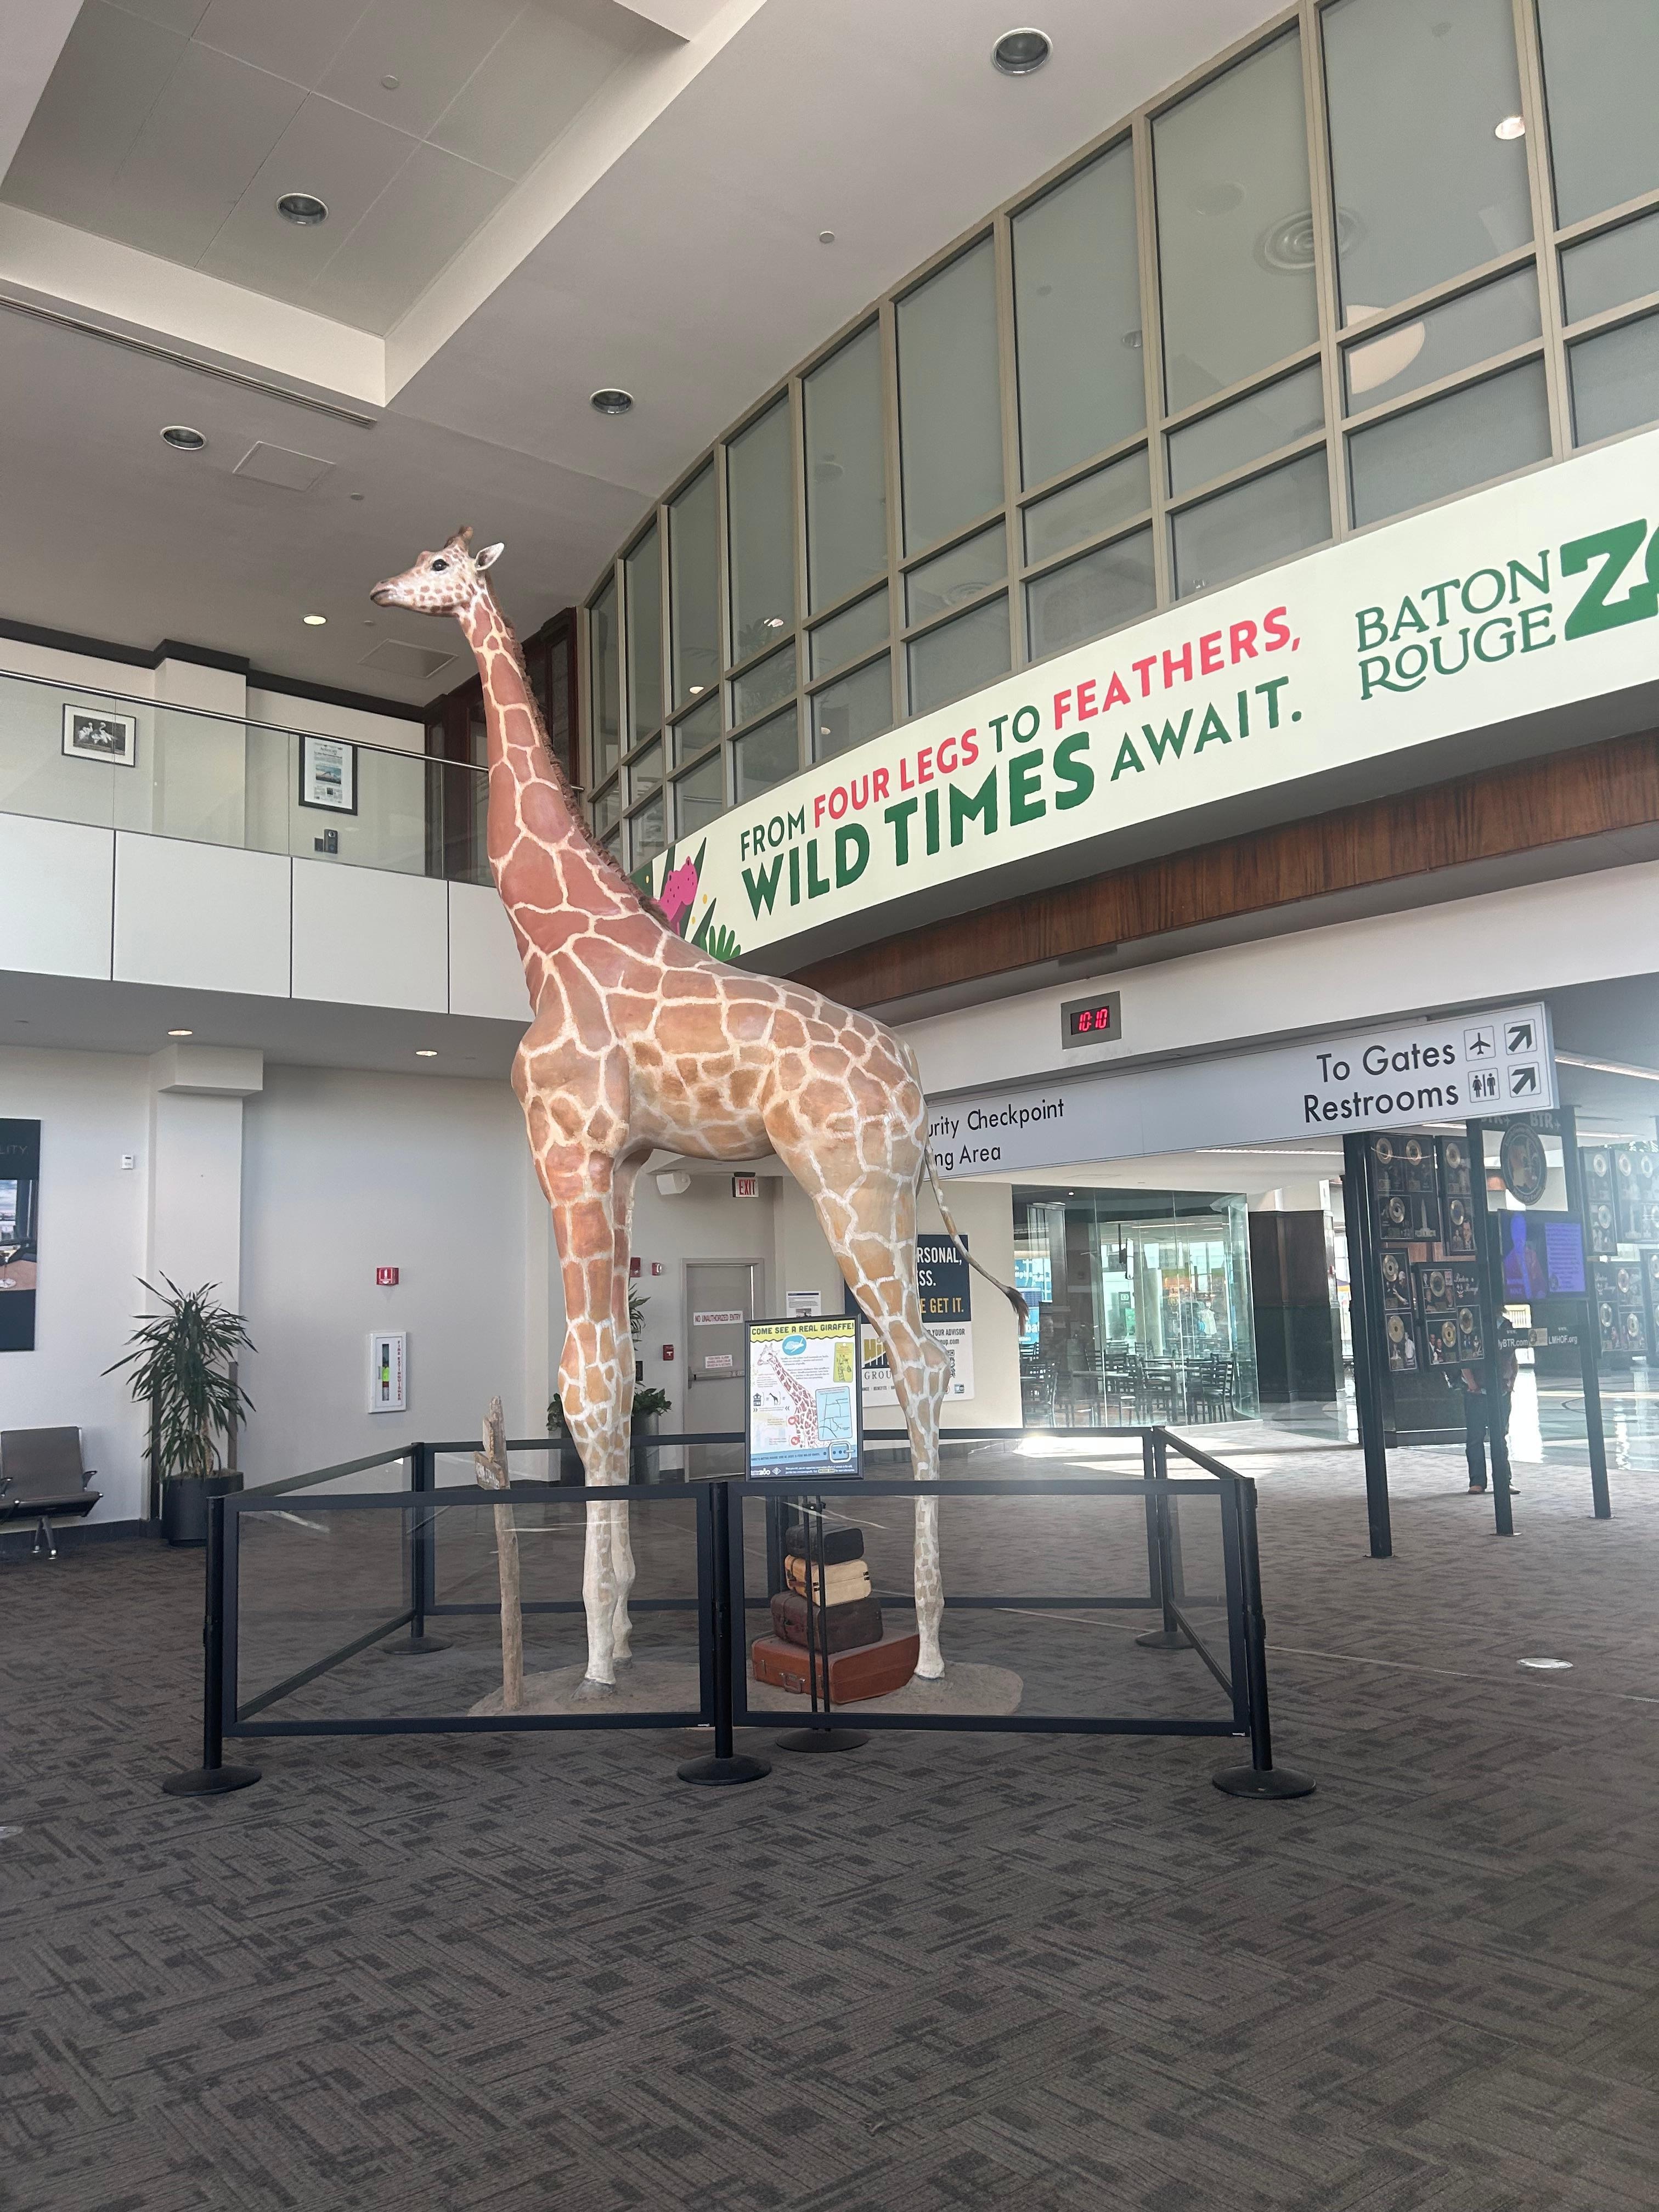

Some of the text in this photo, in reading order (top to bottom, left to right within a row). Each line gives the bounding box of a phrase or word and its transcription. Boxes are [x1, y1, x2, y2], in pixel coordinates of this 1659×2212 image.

[1560, 518, 1659, 641] Z
[1356, 549, 1550, 652] BATON
[1359, 603, 1556, 701] ROUGE
[741, 606, 1301, 861] FROM FOUR LEGS TO FEATHERS,
[742, 676, 1302, 920] WILD TIMES AWAIT.
[1079, 1009, 1108, 1031] 10:10
[1317, 1043, 1455, 1082] To Gates
[967, 1098, 1064, 1130] Checkpoint
[1304, 1085, 1459, 1123] Restrooms
[959, 1144, 1001, 1164] Area
[738, 1179, 755, 1195] EXIT
[917, 1247, 962, 1265] RSONAL,
[930, 1297, 949, 1313] GET
[952, 1297, 964, 1313] IT.
[752, 1327, 772, 1335] COME
[799, 1324, 818, 1333] REAL
[820, 1322, 854, 1331] GIRAFFE!
[1498, 1339, 1528, 1350] lyBTR.com
[1548, 1335, 1578, 1345] LMHOF.org
[864, 1370, 891, 1380] GROU
